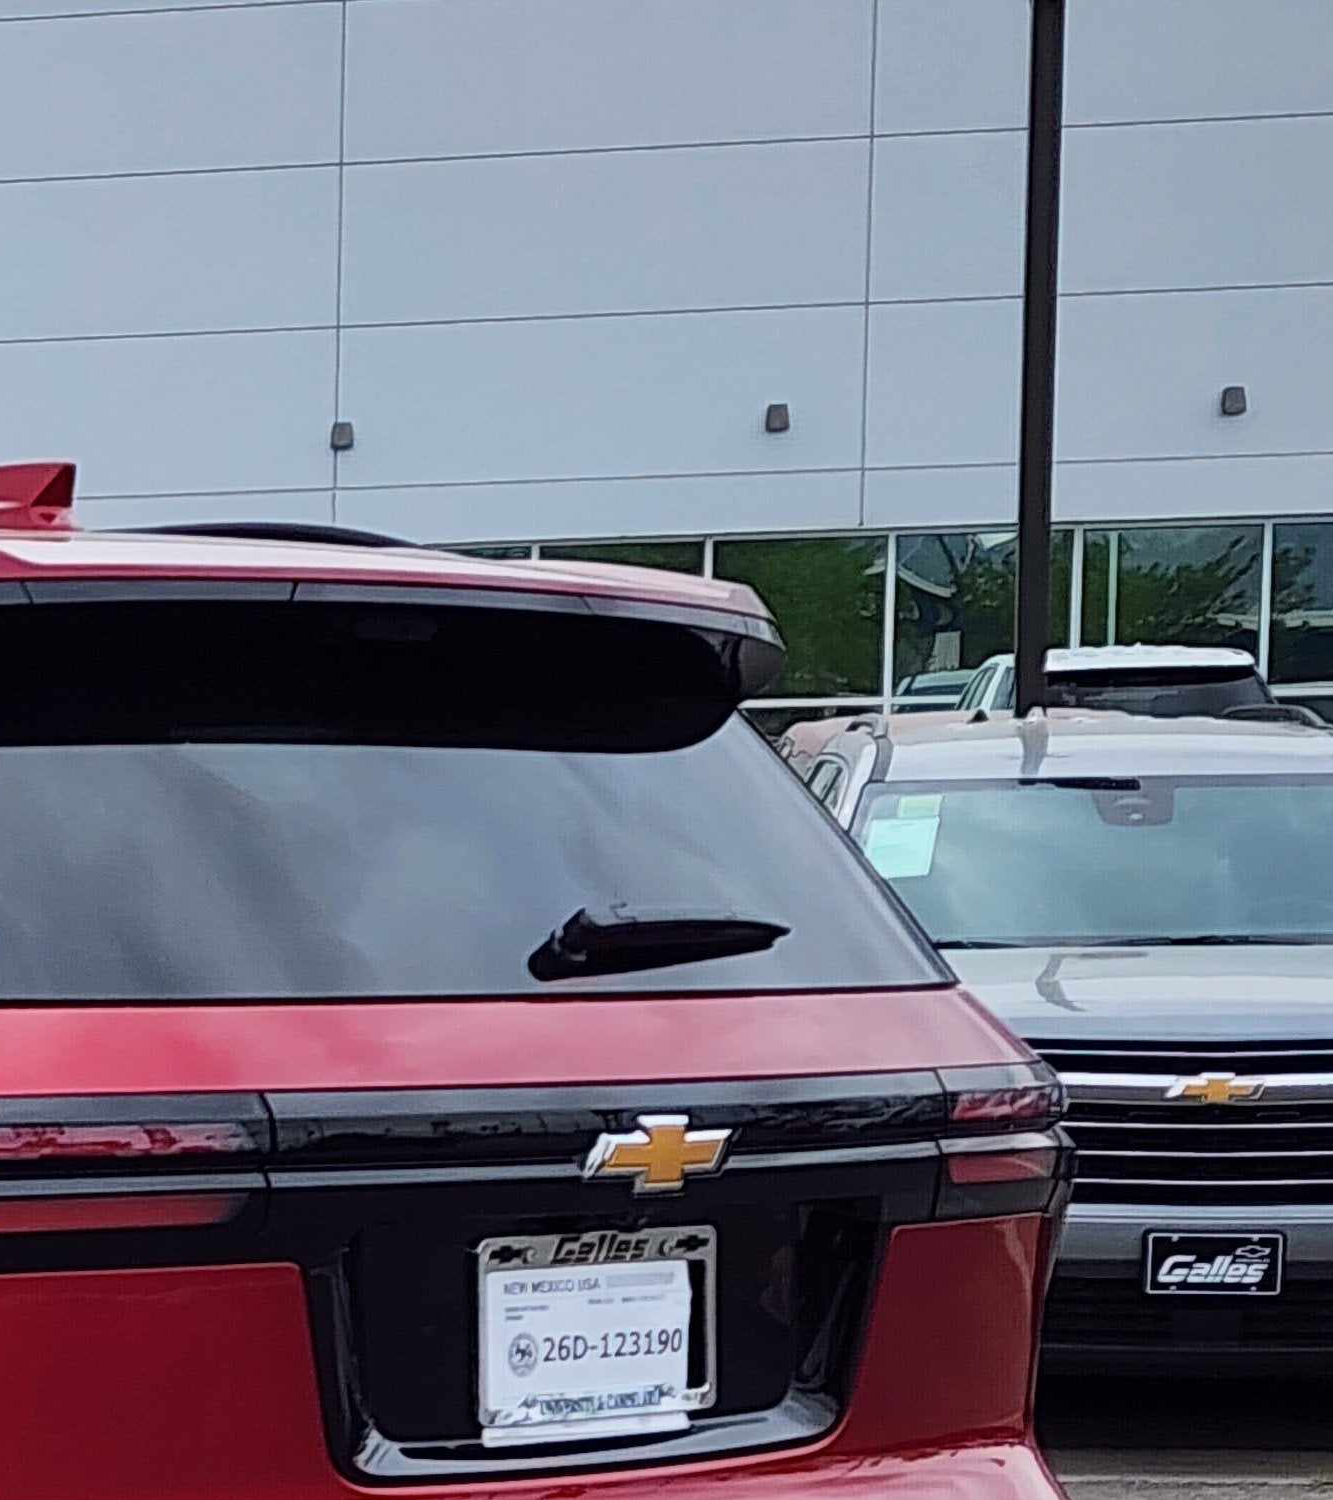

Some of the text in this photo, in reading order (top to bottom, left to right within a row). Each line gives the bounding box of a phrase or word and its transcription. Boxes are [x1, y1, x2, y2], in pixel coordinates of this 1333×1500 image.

[550, 1233, 650, 1264] Galles
[1157, 1255, 1269, 1283] Galles
[532, 1278, 574, 1294] MEXICO
[578, 1277, 601, 1292] USA
[542, 1327, 683, 1363] 26D-123190
